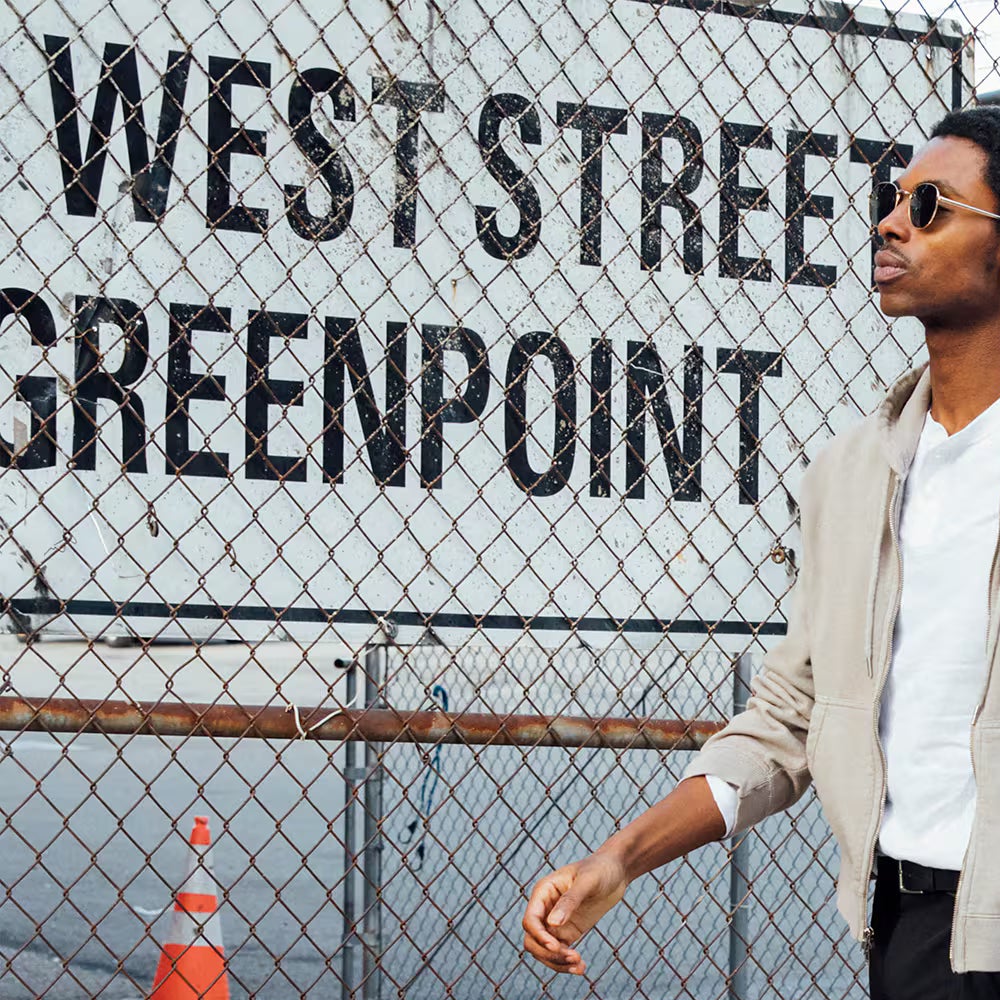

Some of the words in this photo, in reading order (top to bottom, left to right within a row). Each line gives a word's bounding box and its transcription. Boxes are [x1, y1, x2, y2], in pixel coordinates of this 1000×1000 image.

[44, 34, 445, 248] WEST
[475, 92, 914, 292] STREET
[0, 286, 783, 505] GREENPOINT
